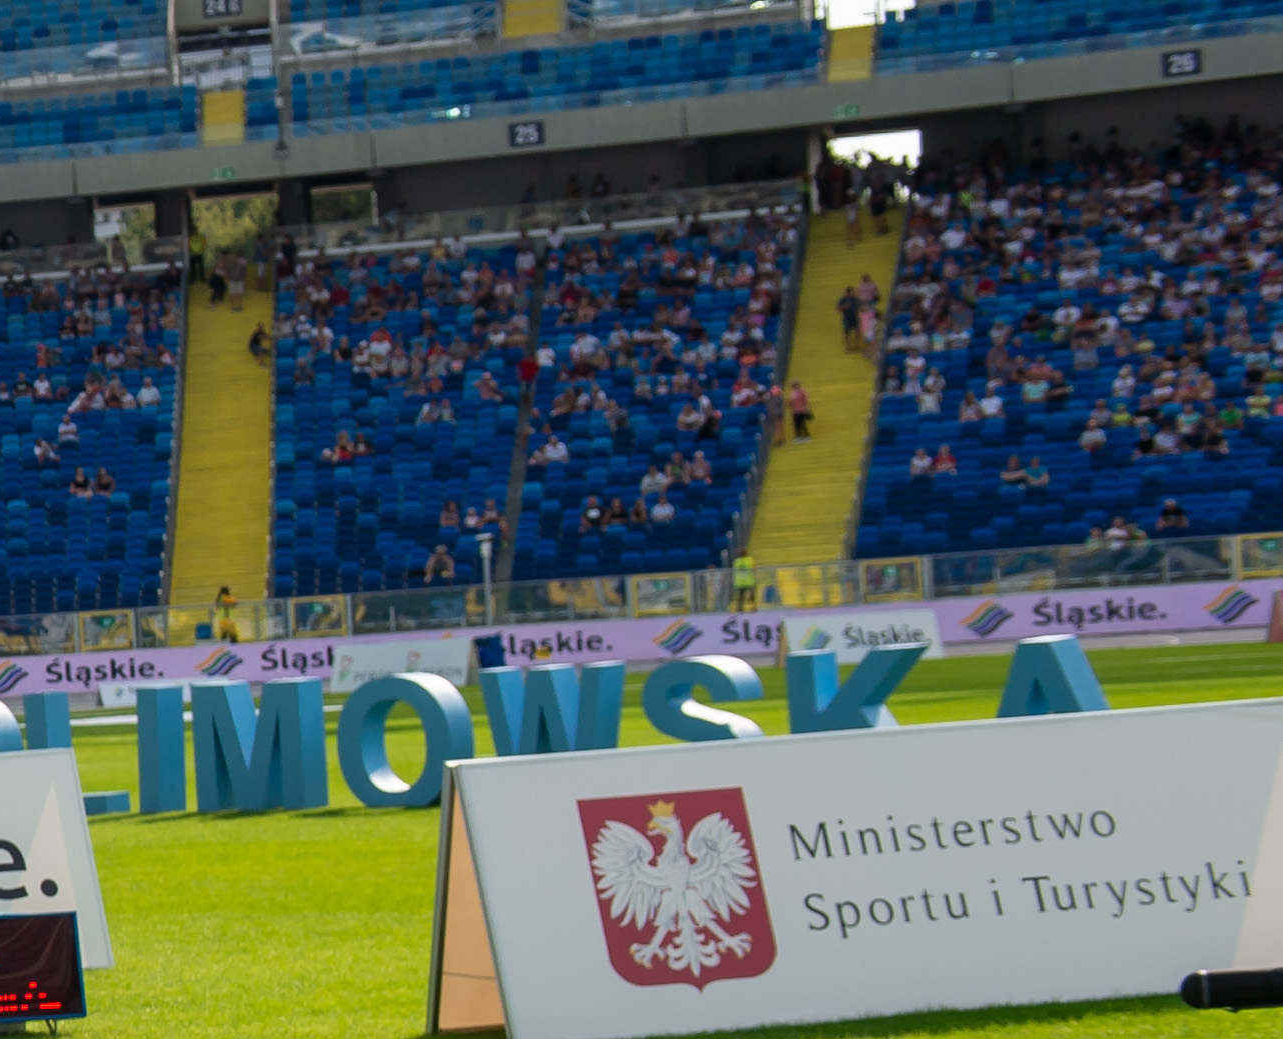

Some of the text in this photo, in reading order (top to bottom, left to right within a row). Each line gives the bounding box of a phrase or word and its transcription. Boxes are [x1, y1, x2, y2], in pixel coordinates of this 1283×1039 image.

[1033, 596, 1168, 631] Śląskie.
[500, 630, 614, 661] ląskie.
[45, 657, 164, 687] Śląskie.
[787, 808, 1118, 861] Ministerstwo
[802, 860, 1254, 939] Sportu i Turystyki
